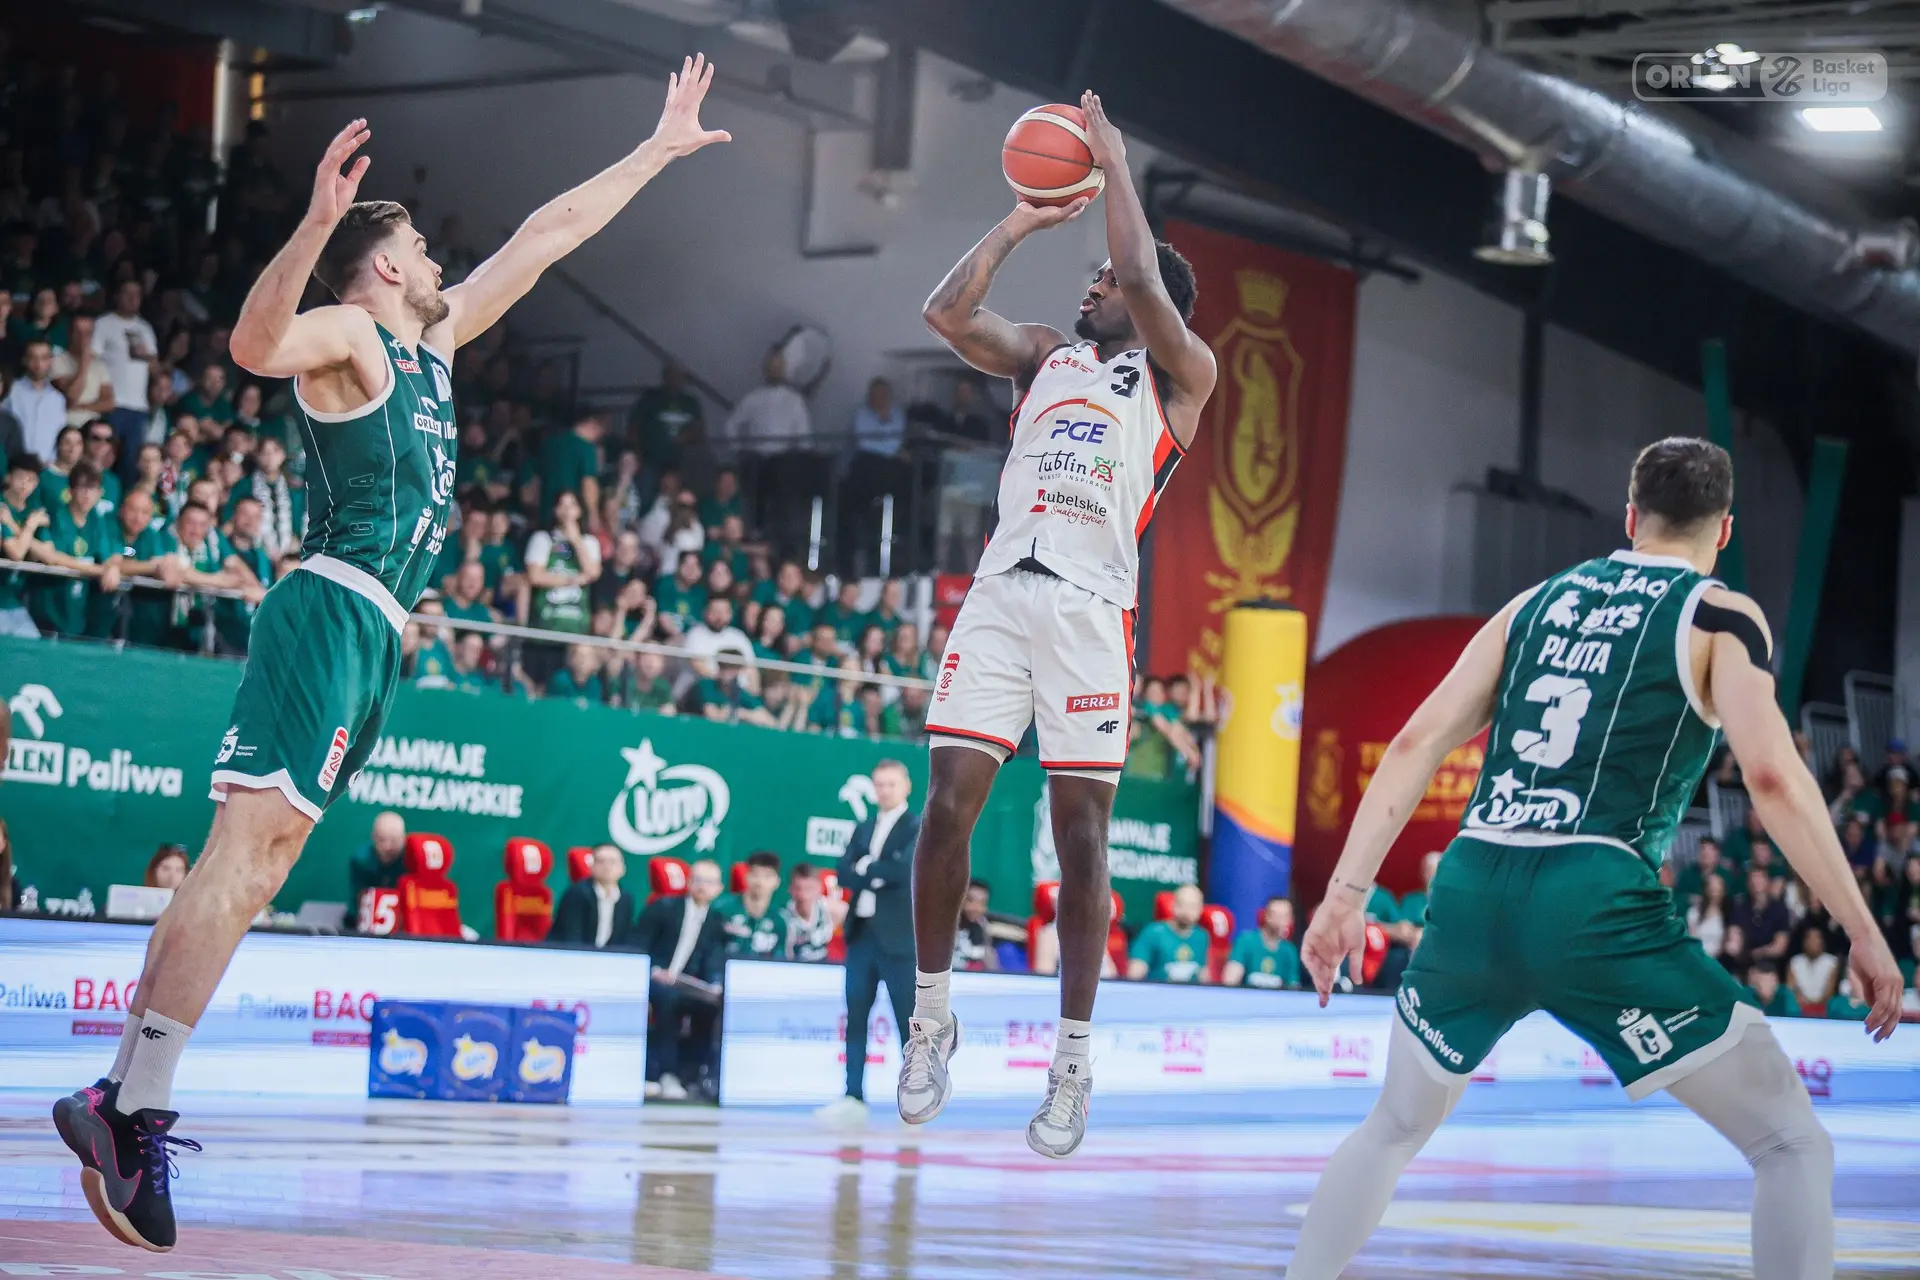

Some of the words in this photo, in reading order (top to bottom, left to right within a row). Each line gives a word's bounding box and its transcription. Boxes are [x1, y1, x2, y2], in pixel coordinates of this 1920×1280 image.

[1110, 365, 1141, 399] 3
[1050, 419, 1108, 444] PGE
[1065, 474, 1112, 492] INSPIRACJI
[1536, 634, 1612, 674] PLUTA
[1072, 696, 1115, 710] PERŁA
[1096, 720, 1120, 734] 4F
[1511, 673, 1593, 769] 3
[66, 747, 183, 798] Paliwa
[348, 771, 524, 819] WARSZAWSKIE
[1486, 798, 1560, 823] LOTTO
[141, 1026, 168, 1041] 4F
[1418, 1017, 1464, 1065] Paliwa
